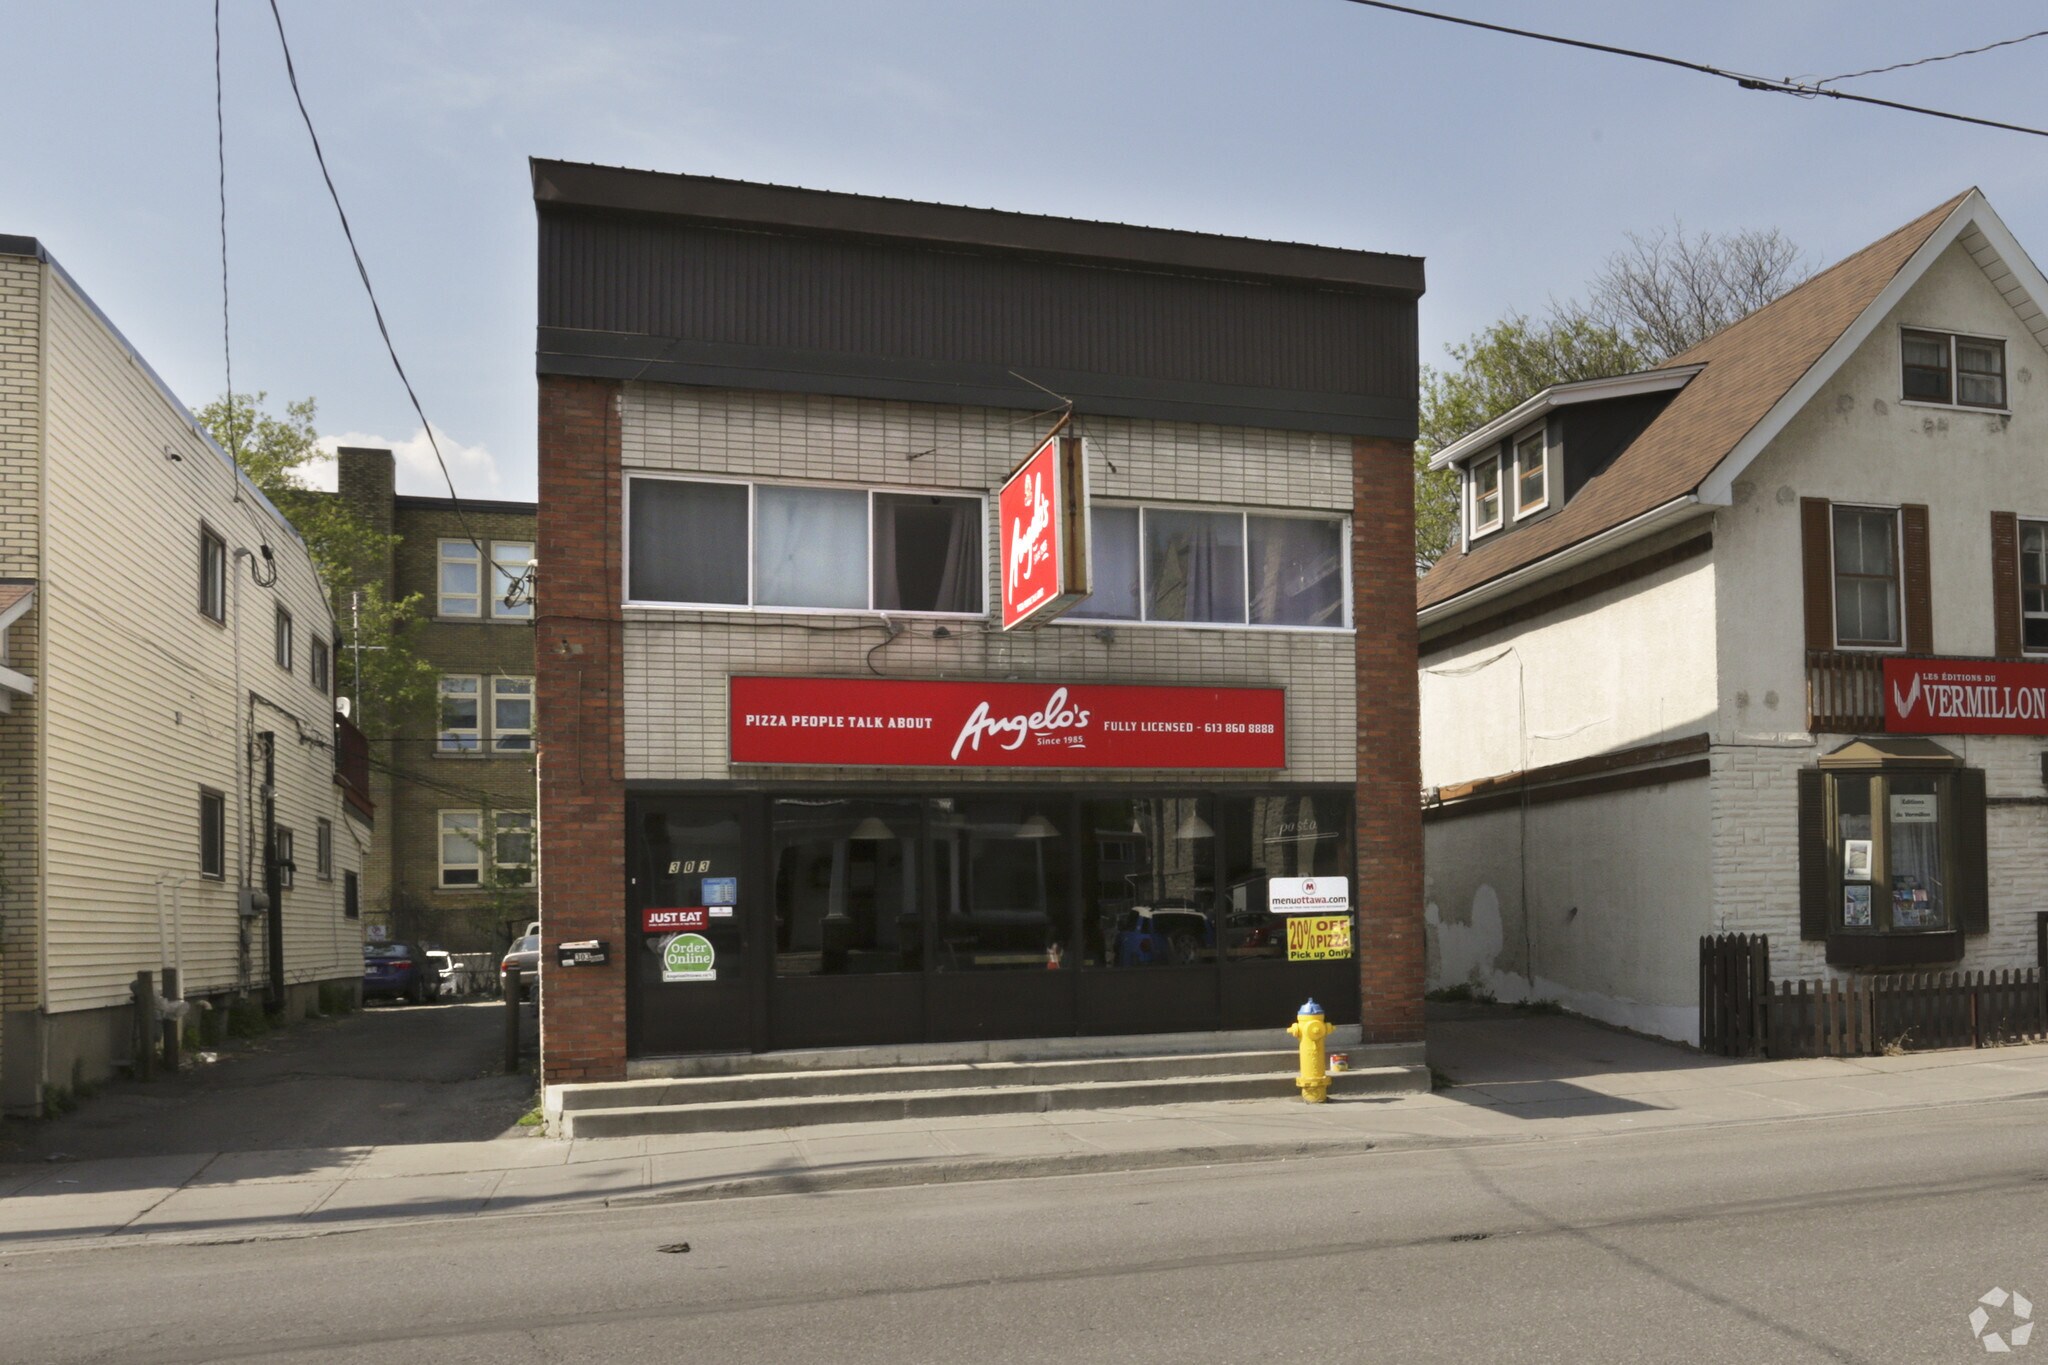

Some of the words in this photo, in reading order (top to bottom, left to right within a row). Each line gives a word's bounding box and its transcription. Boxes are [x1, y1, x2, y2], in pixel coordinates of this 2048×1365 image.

[1942, 672, 1981, 682] ÉDITIONS
[1923, 685, 2046, 719] VERMILLON
[746, 715, 787, 726] PIZZA
[792, 716, 844, 727] PEOPLE
[848, 716, 884, 728] TALK
[888, 717, 933, 729] ABOUT
[951, 687, 1091, 760] Angelo's
[1104, 721, 1138, 732] FULLY
[1141, 722, 1193, 732] LICENSED
[1204, 723, 1222, 733] 613
[1225, 723, 1245, 733] 860
[1248, 724, 1274, 734] 8888
[1037, 737, 1060, 746] Since
[1063, 736, 1083, 744] 1985
[1279, 819, 1317, 835] pasta
[670, 861, 709, 873] 303
[1272, 896, 1346, 905] menuottawa.com
[649, 913, 678, 923] JUST
[679, 911, 703, 922] EAT
[1316, 920, 1348, 931] OFF
[1290, 919, 1315, 950] 20%
[1316, 934, 1350, 948] PIZZA
[671, 942, 707, 953] Order
[668, 953, 710, 965] Online
[1290, 951, 1311, 959] Pick
[1314, 952, 1325, 960] up
[1328, 949, 1350, 958] Only
